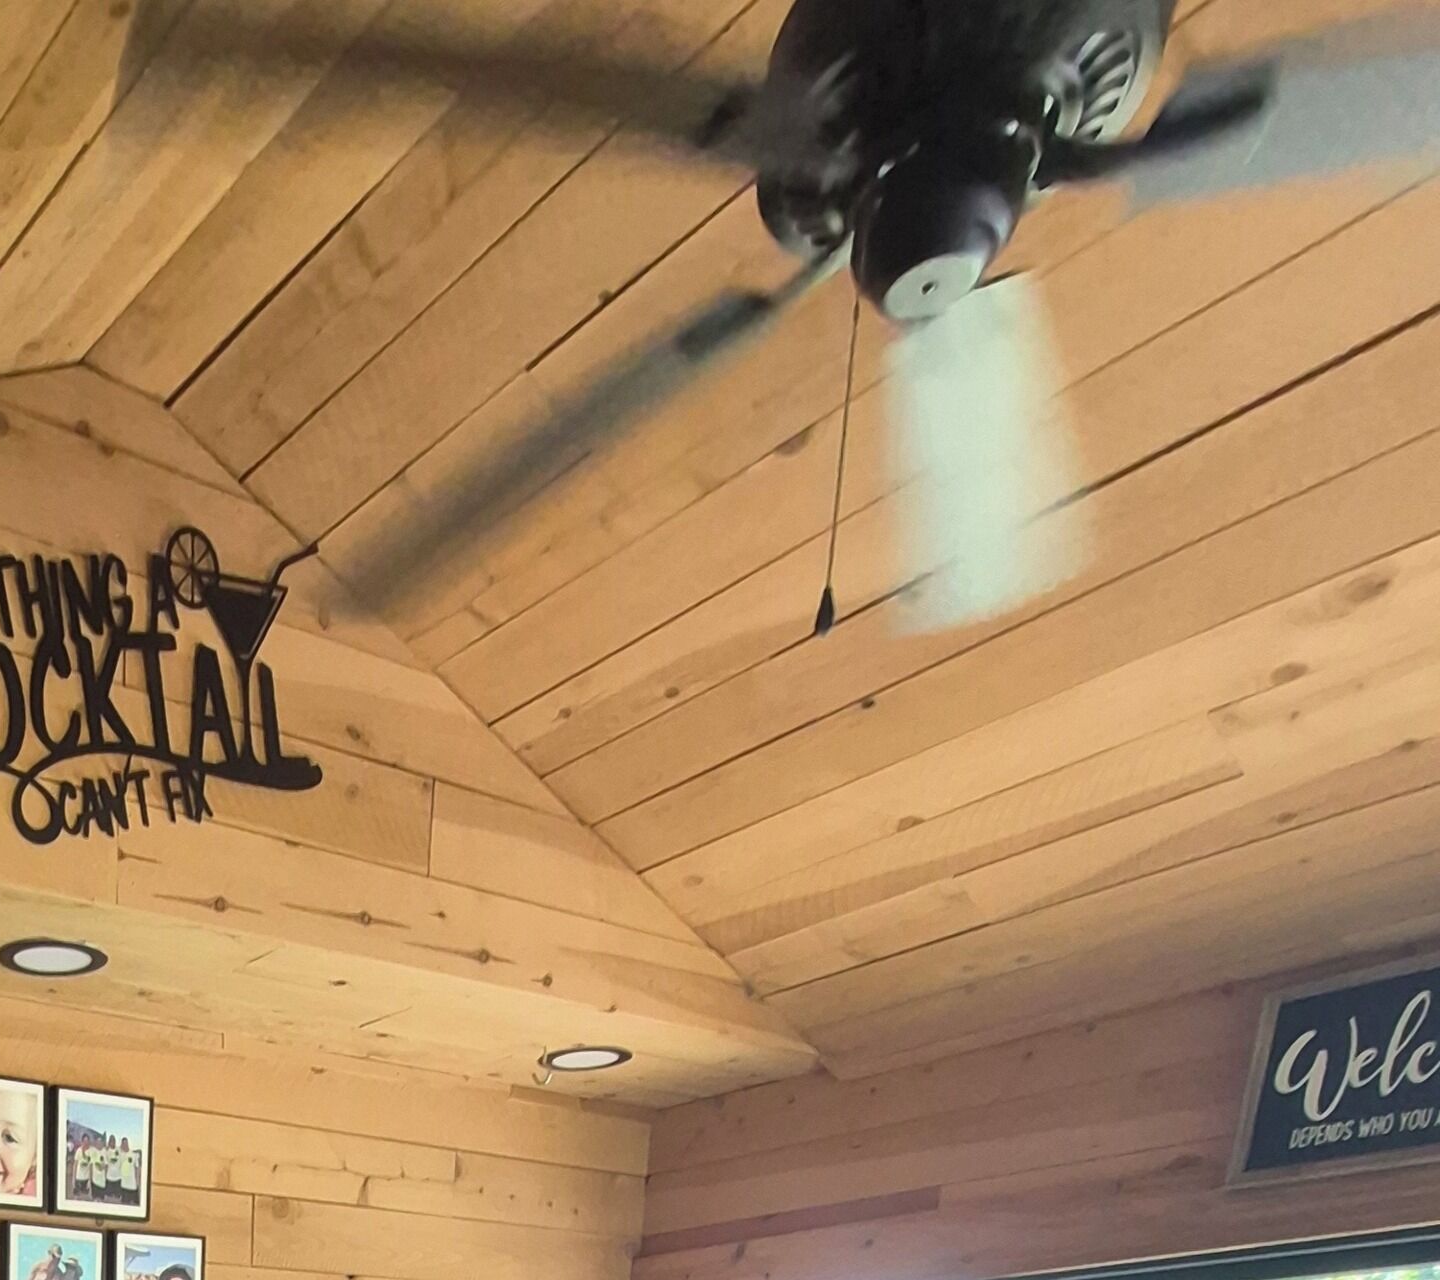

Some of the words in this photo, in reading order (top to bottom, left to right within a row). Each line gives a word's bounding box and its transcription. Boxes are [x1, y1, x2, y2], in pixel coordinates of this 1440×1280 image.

[150, 553, 181, 634] A
[162, 766, 214, 824] FIX
[1288, 1119, 1355, 1150] DEPENDS
[1358, 1112, 1395, 1139] WHO
[1399, 1107, 1435, 1132] YOU
